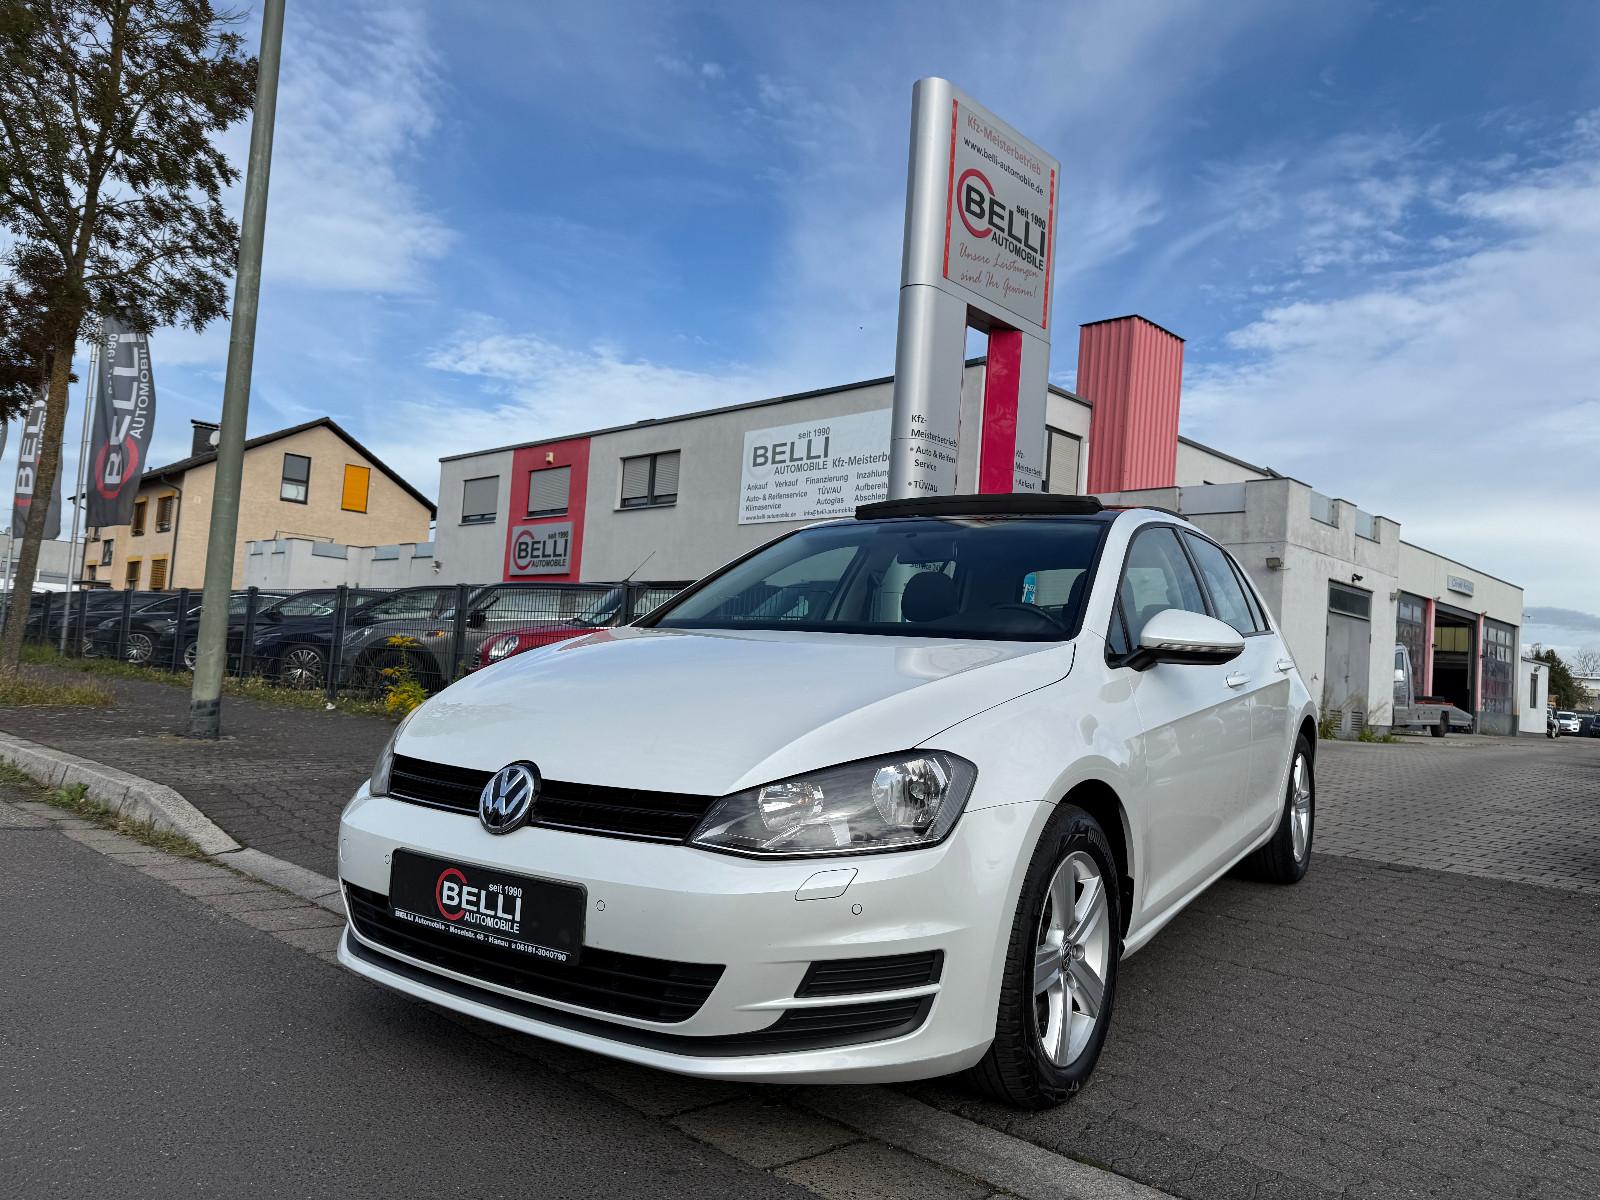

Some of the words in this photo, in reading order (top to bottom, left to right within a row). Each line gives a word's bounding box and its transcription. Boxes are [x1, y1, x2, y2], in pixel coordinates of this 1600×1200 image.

[967, 114, 1041, 175] Kfz-Meisterbetrieb
[963, 137, 1044, 196] www.belli-automobile.de
[965, 183, 1046, 258] BELLI
[1016, 205, 1029, 219] seit
[1030, 212, 1046, 230] 1990
[959, 243, 990, 265] Unsere
[994, 257, 1040, 279] Leistungen
[991, 231, 1044, 272] AUTOMOBILE
[960, 271, 982, 288] sind
[986, 273, 999, 289] Ihr
[1002, 278, 1038, 299] Gewinn!
[107, 333, 118, 362] 1990
[129, 332, 150, 439] AUTOMOBILE
[911, 414, 927, 424] Kfz-
[798, 431, 812, 440] seit
[814, 426, 831, 437] 1990
[911, 428, 957, 448] Meisterbetrieb
[752, 436, 830, 467] BELLI
[915, 445, 932, 457] Auto
[932, 449, 938, 459] &
[938, 451, 956, 464] Reifen
[774, 460, 828, 476] AUTOMOBILE
[914, 459, 937, 472] Service
[747, 481, 768, 491] Ankauf
[775, 478, 799, 488] Verkauf
[805, 474, 849, 485] Finanzierung
[913, 479, 938, 493] TÜV/AU
[745, 503, 782, 512] Klimaservice
[816, 497, 844, 506] Autoglas
[768, 491, 808, 501] Reifenservice
[518, 538, 568, 560] BELLI
[531, 559, 567, 568] AUTOMOBILE
[442, 880, 522, 922] BELLI
[488, 883, 503, 894] seit
[504, 885, 523, 898] 1990
[464, 911, 520, 934] AUTOMOBILE
[395, 910, 413, 921] BELLI
[415, 916, 445, 930] Automobile
[488, 935, 509, 947] Hanau
[516, 943, 567, 961] 06181-3040790
